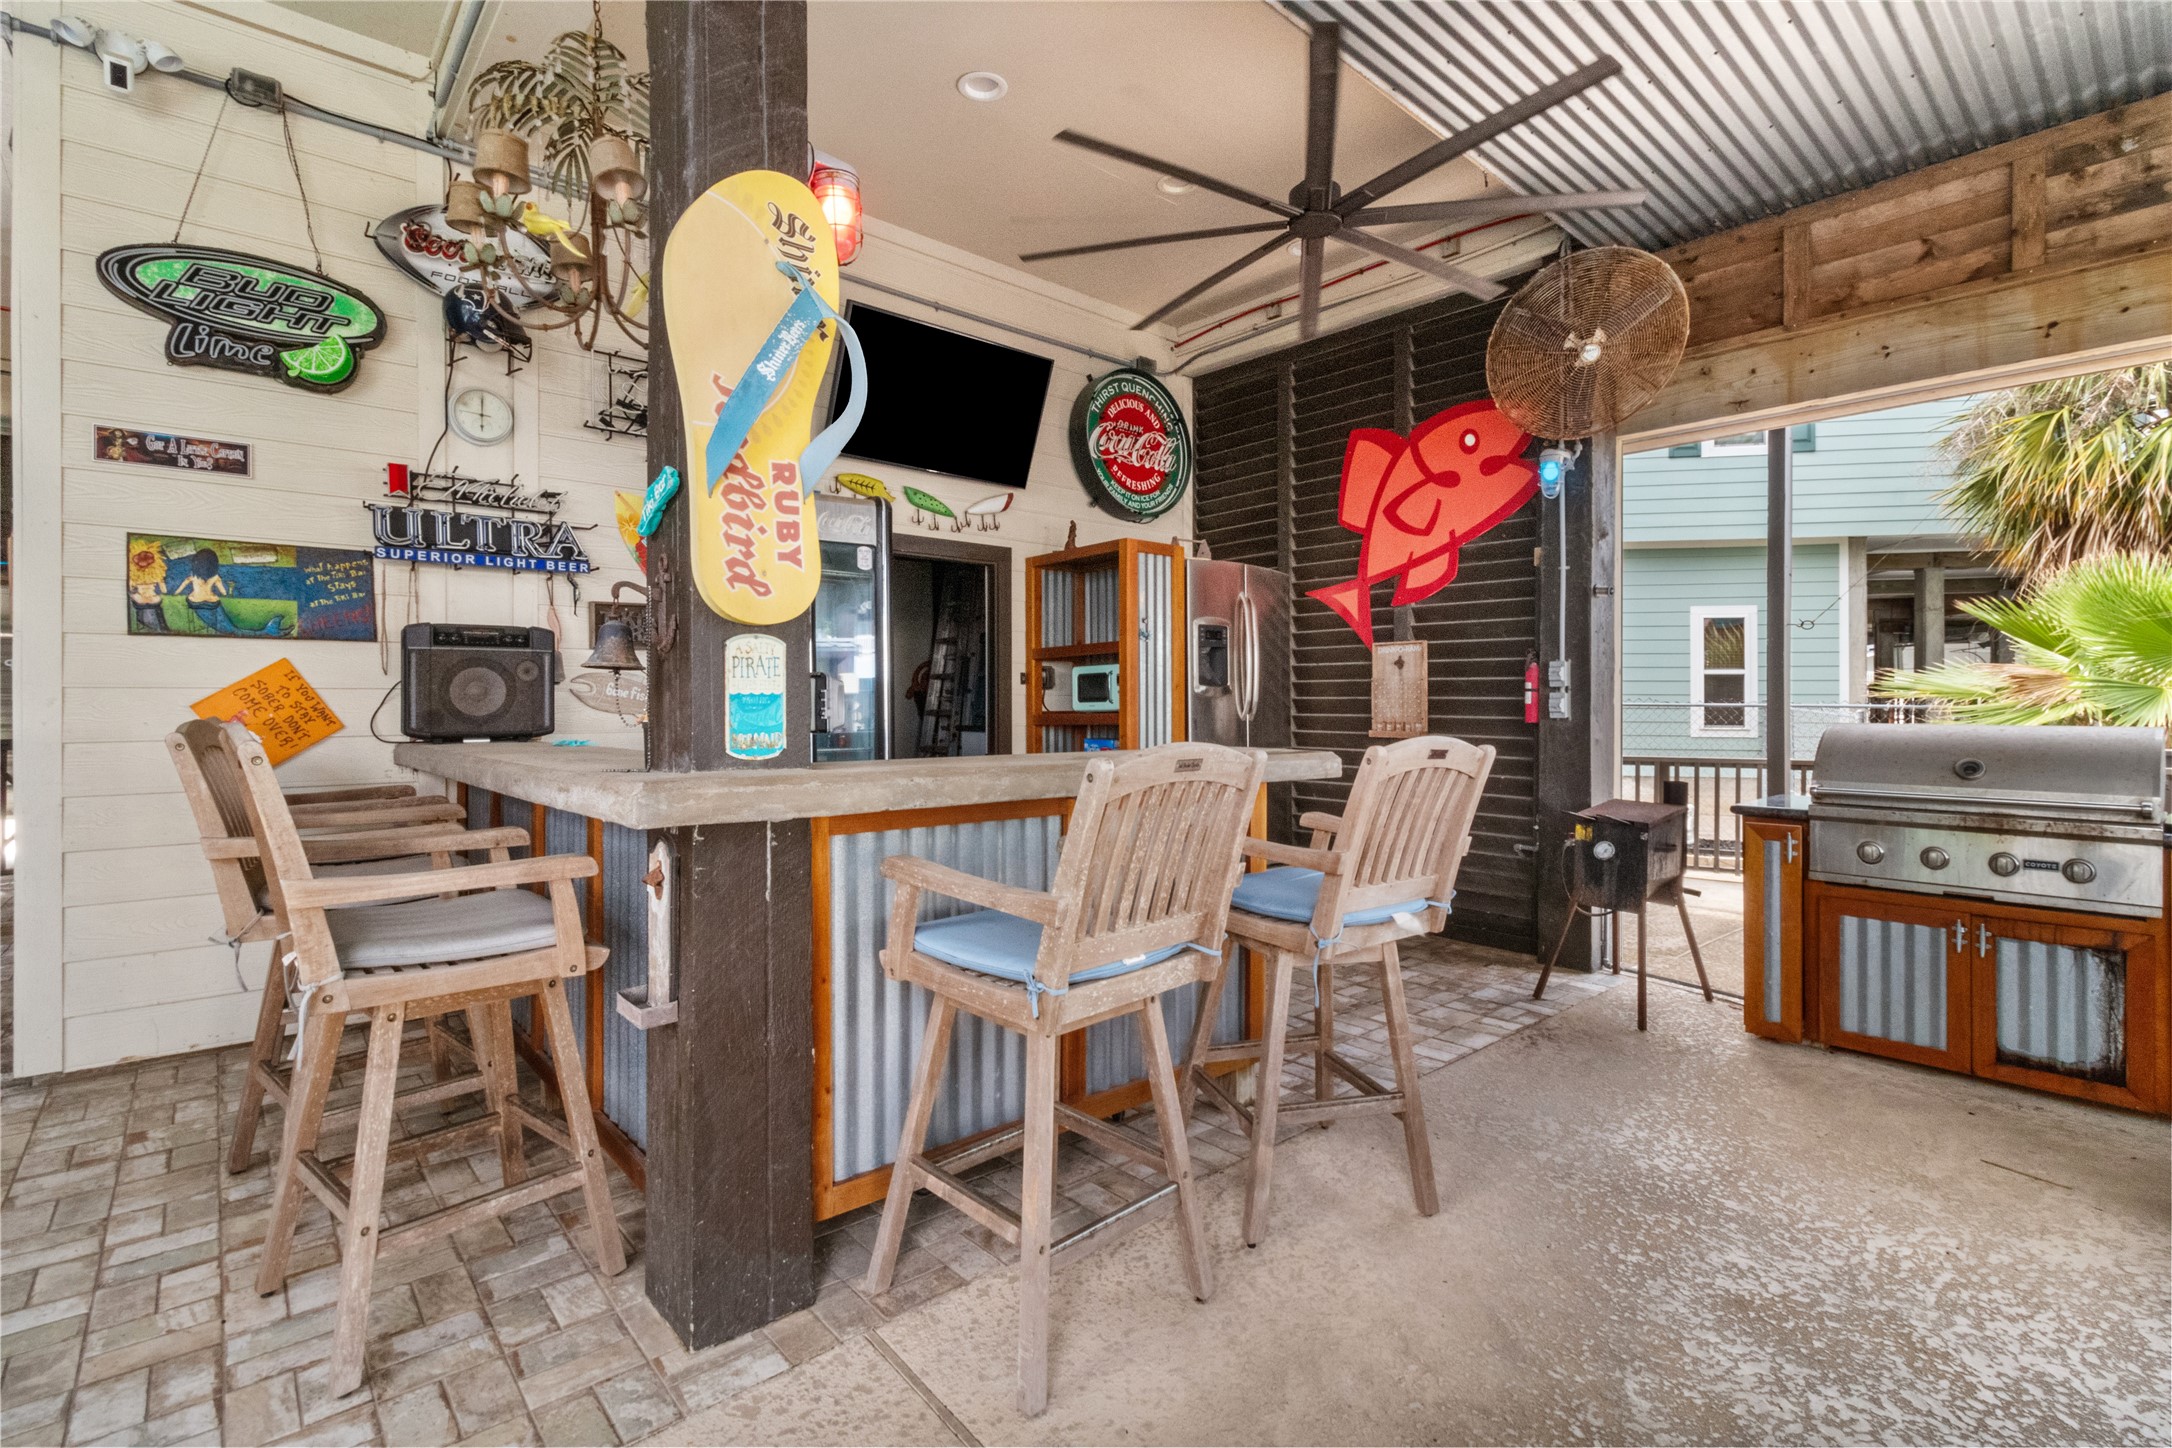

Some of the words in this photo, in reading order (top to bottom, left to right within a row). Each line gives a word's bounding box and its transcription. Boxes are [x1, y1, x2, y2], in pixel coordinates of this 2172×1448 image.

[150, 279, 352, 334] LIGHT
[180, 264, 334, 313] BUD
[170, 323, 274, 366] Lime
[756, 341, 790, 382] Shiner
[1091, 383, 1119, 413] THIRST
[1121, 381, 1174, 432] QUENCHING
[1107, 398, 1144, 419] DELICIOUS
[1144, 410, 1161, 429] AND
[167, 438, 178, 453] A
[1117, 420, 1144, 434] DRINK
[1109, 485, 1128, 504] FAMILY
[1127, 501, 1141, 509] AND
[1141, 500, 1156, 509] YOUR
[1155, 483, 1174, 505] FRIENDS
[1110, 480, 1125, 494] KEEP
[1150, 490, 1161, 500] FOR
[1112, 464, 1161, 491] REFRESHING
[372, 505, 589, 560] ULTRA
[771, 461, 803, 569] RUBY
[375, 547, 476, 566] SUPERIOR
[485, 555, 538, 570] LIGHT
[546, 560, 590, 573] BEER
[732, 655, 781, 678] PIRATE
[232, 687, 268, 718] COME
[262, 717, 299, 749] OVER!
[250, 680, 285, 713] SOBER
[283, 715, 311, 741] DON'T
[275, 685, 291, 699] TO
[290, 701, 317, 724] STAY
[296, 683, 313, 702] YOU
[310, 702, 336, 727] WANT
[2024, 861, 2058, 870] COYOTE
